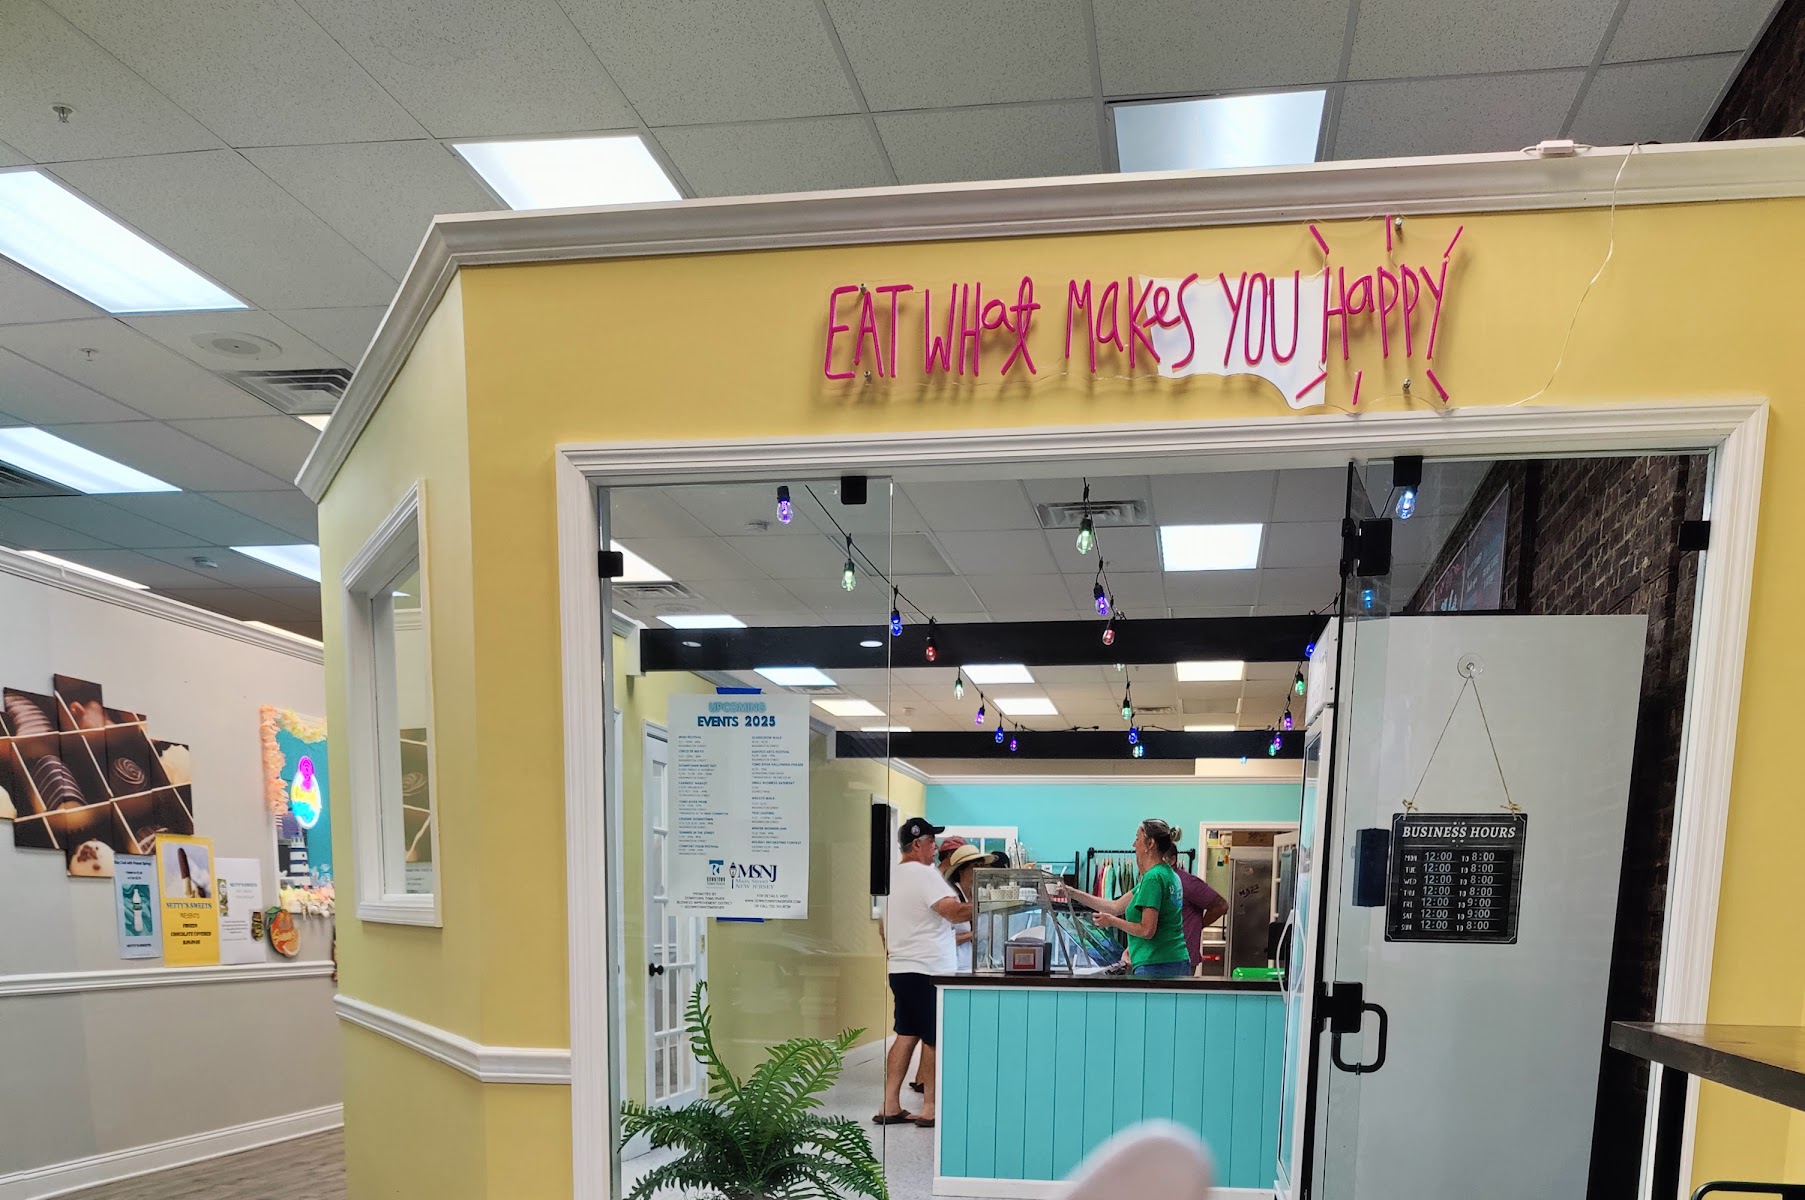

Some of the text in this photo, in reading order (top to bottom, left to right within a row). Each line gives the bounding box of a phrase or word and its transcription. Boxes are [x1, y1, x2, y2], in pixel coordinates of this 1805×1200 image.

[825, 284, 913, 379] EAT
[1219, 270, 1300, 368] YOU
[708, 701, 766, 713] UPCOMING
[697, 715, 776, 727] EVENTS 2025
[1401, 826, 1517, 838] BUSINESS HOURS
[1424, 852, 1453, 861] 12:00
[1471, 852, 1495, 861] 8:00
[737, 864, 778, 883] MSNJ
[1405, 866, 1417, 874] TUE
[1423, 863, 1451, 873] 12:00
[1470, 863, 1494, 873] 8:00
[1424, 875, 1452, 885] 12:00
[1459, 878, 1468, 886] TO
[1470, 875, 1494, 885] 8:00
[1422, 886, 1451, 896] 12:00
[1469, 886, 1493, 896] 8:00
[1421, 897, 1449, 907] 12:00
[1467, 898, 1491, 908] 9:00
[1402, 912, 1413, 920] SAT
[1420, 909, 1449, 919] 12:00
[1466, 909, 1491, 919] 9:00
[1420, 920, 1448, 930] 12:00
[1466, 920, 1490, 930] 8:00
